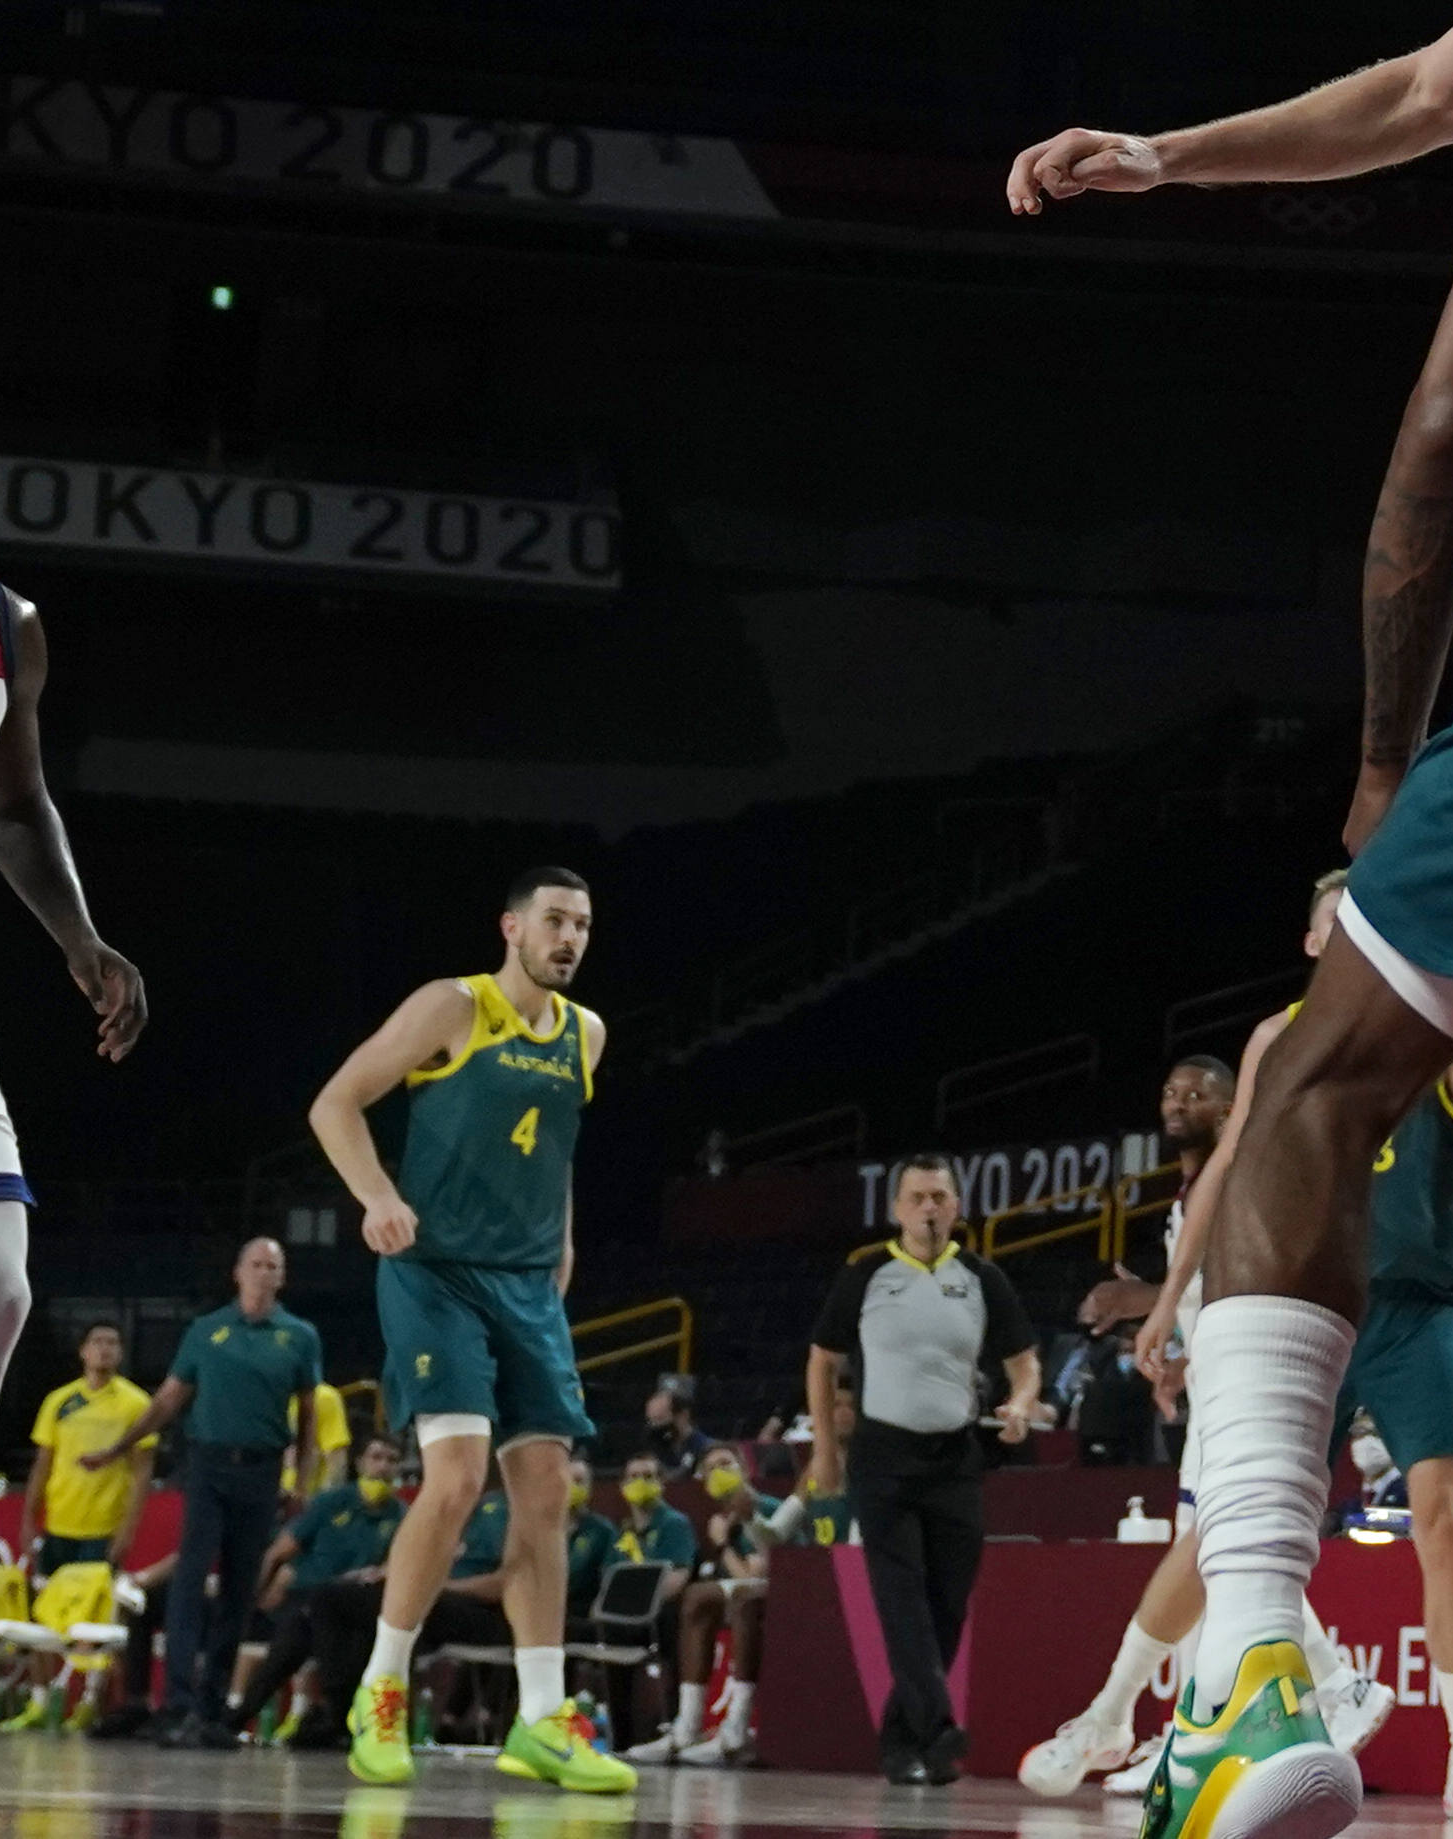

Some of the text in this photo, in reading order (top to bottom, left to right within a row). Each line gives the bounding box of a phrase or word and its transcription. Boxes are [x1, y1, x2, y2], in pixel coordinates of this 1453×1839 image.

[279, 100, 594, 202] 2020
[3, 463, 623, 578] OKYO 2020
[510, 1106, 541, 1157] 4
[857, 1152, 1013, 1229] TYO
